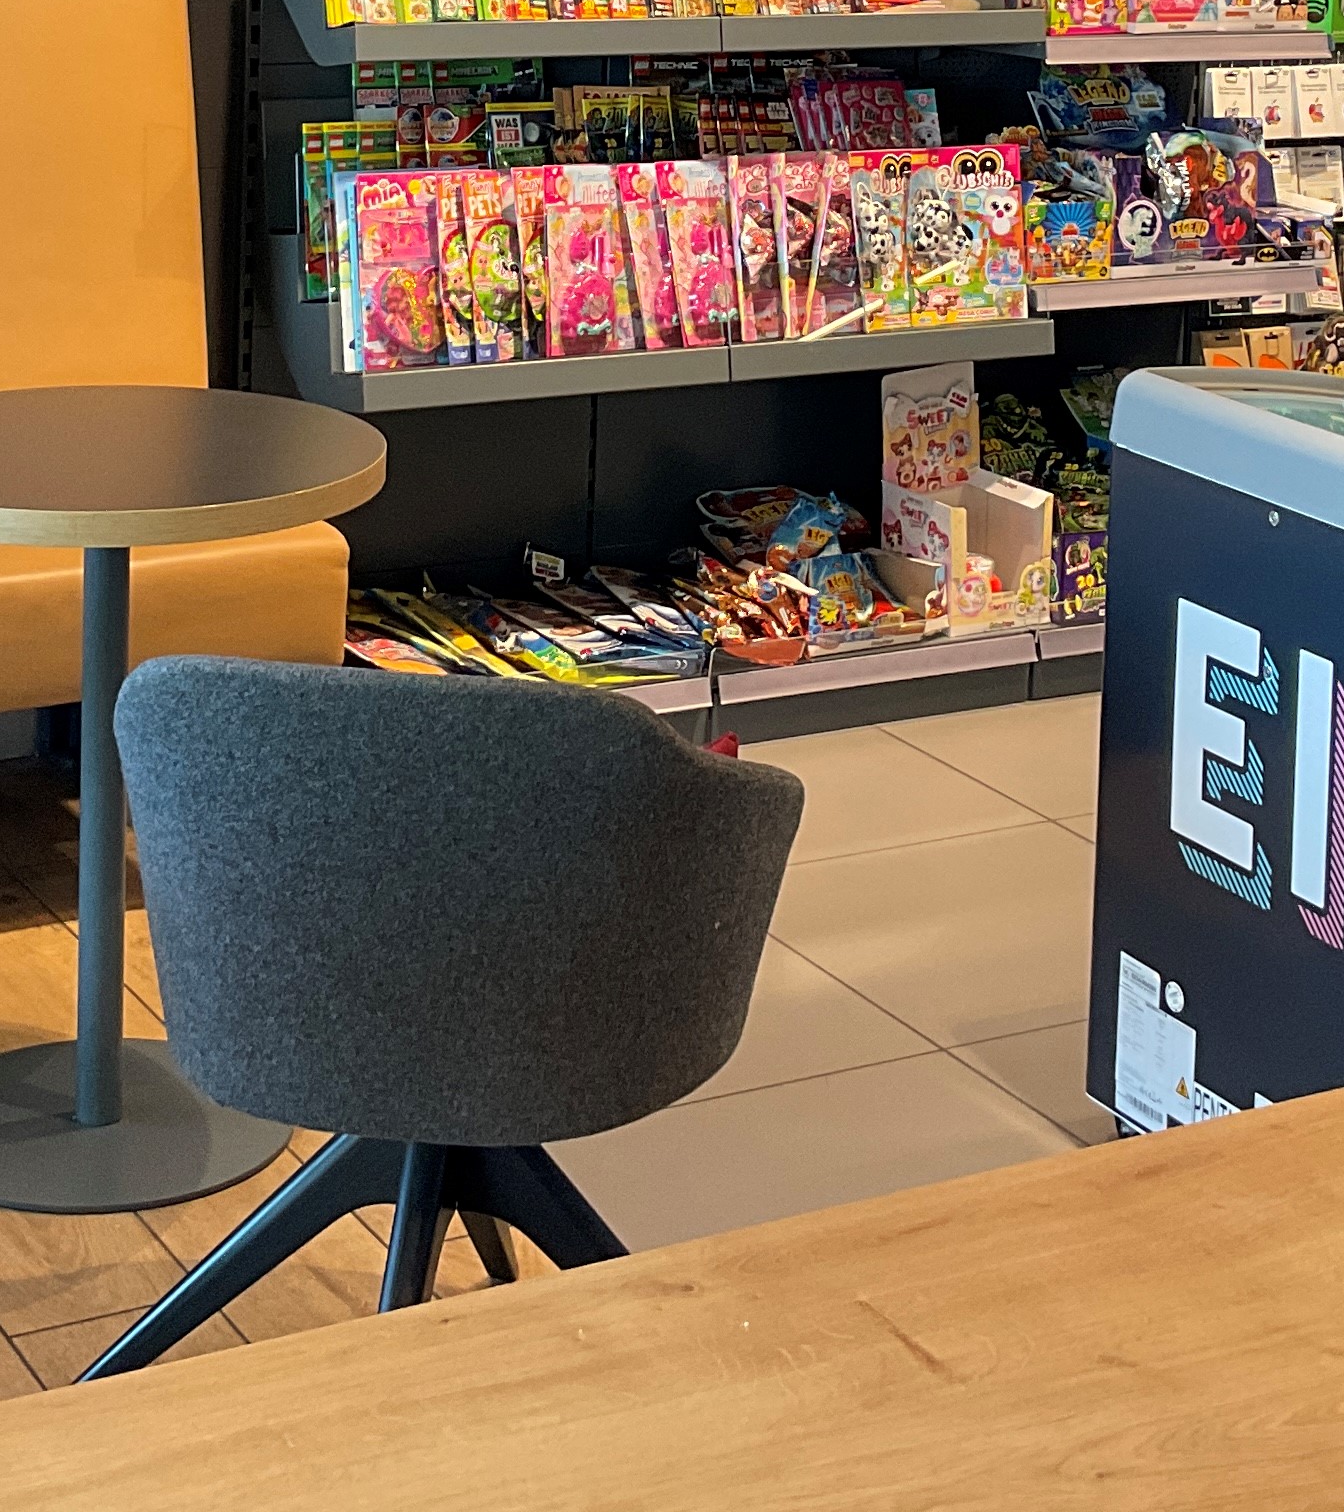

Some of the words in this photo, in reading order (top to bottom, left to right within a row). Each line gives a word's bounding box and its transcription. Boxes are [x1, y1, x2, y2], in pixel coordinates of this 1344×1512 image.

[653, 61, 699, 70] TECHNIC
[769, 58, 814, 67] TECHNIC
[1072, 81, 1130, 104] LEGEND
[494, 118, 519, 129] WAS
[467, 194, 501, 217] PETS
[1171, 218, 1208, 236] LEGEND
[907, 406, 954, 430] SWEET
[1195, 1087, 1233, 1119] PENT
